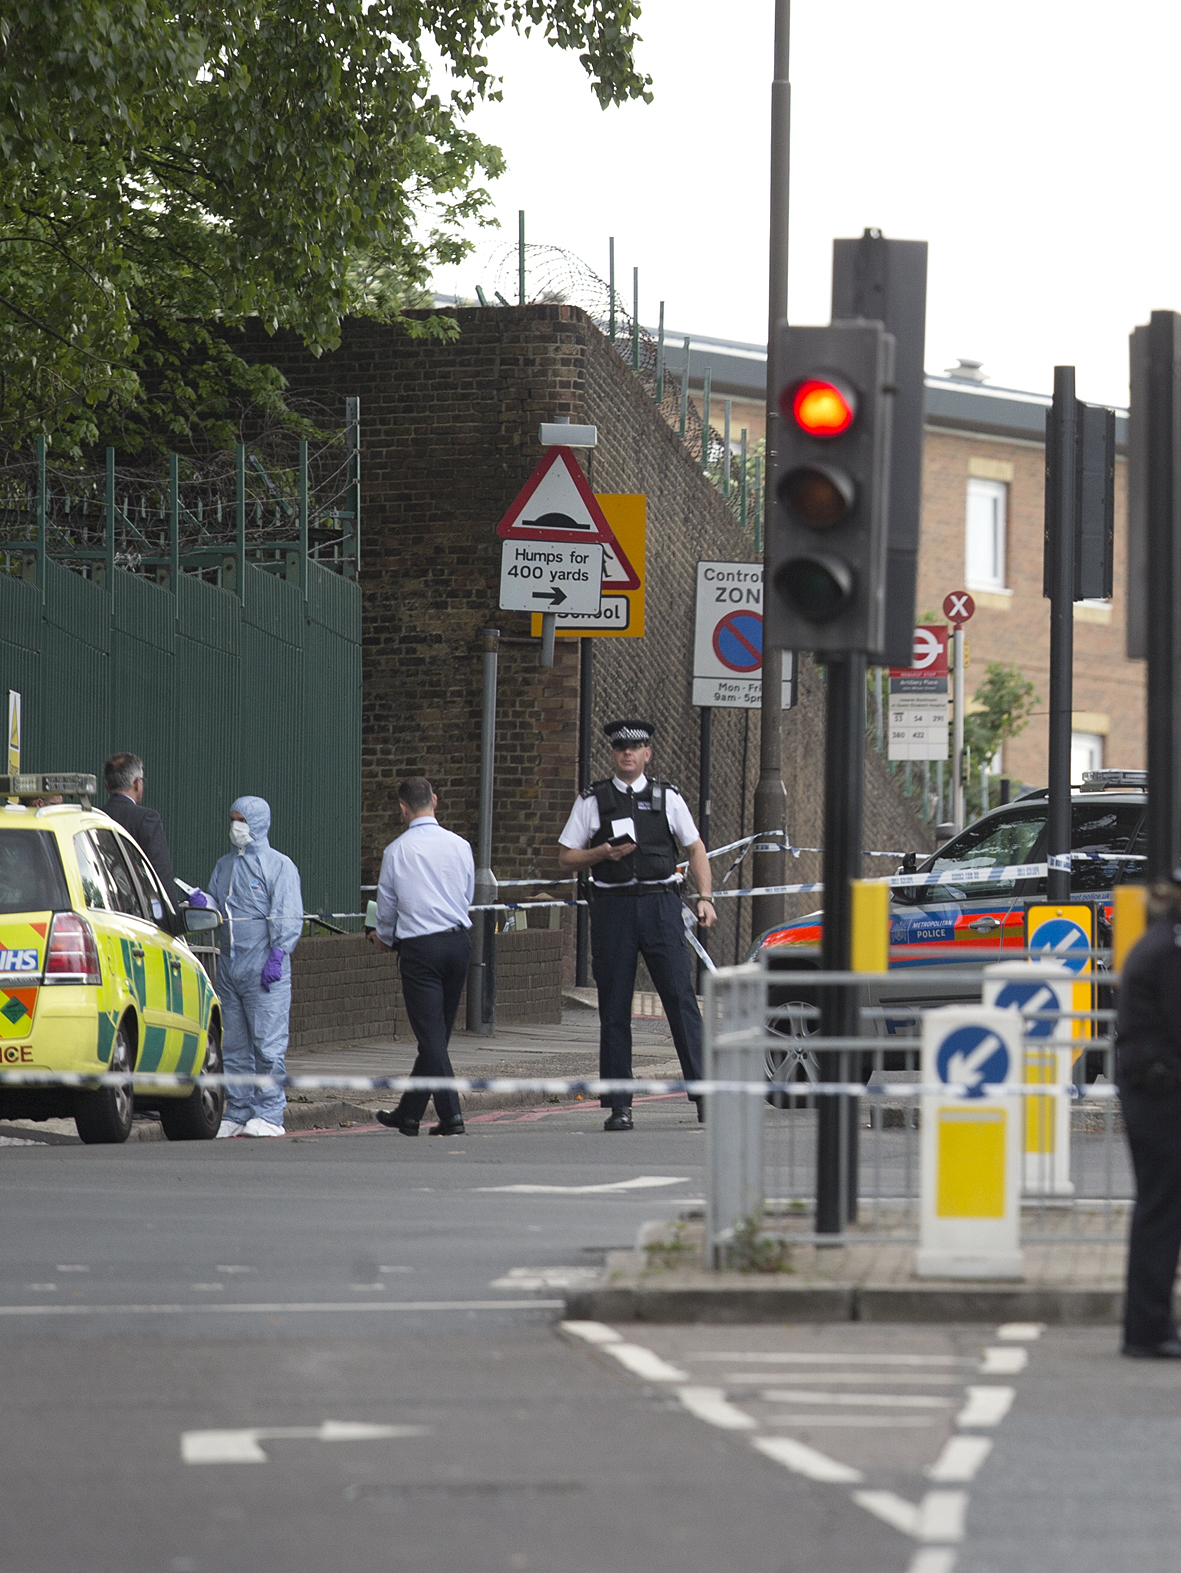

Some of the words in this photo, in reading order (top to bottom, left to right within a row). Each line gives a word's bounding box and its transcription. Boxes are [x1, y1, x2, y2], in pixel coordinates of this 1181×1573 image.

[515, 548, 563, 565] Humps
[570, 551, 589, 564] for
[507, 565, 543, 579] 400
[549, 569, 589, 582] yards
[718, 683, 740, 691] Mon
[714, 692, 736, 702] 9am
[912, 919, 952, 929] METROPOLITAN
[916, 929, 946, 938] POLICE
